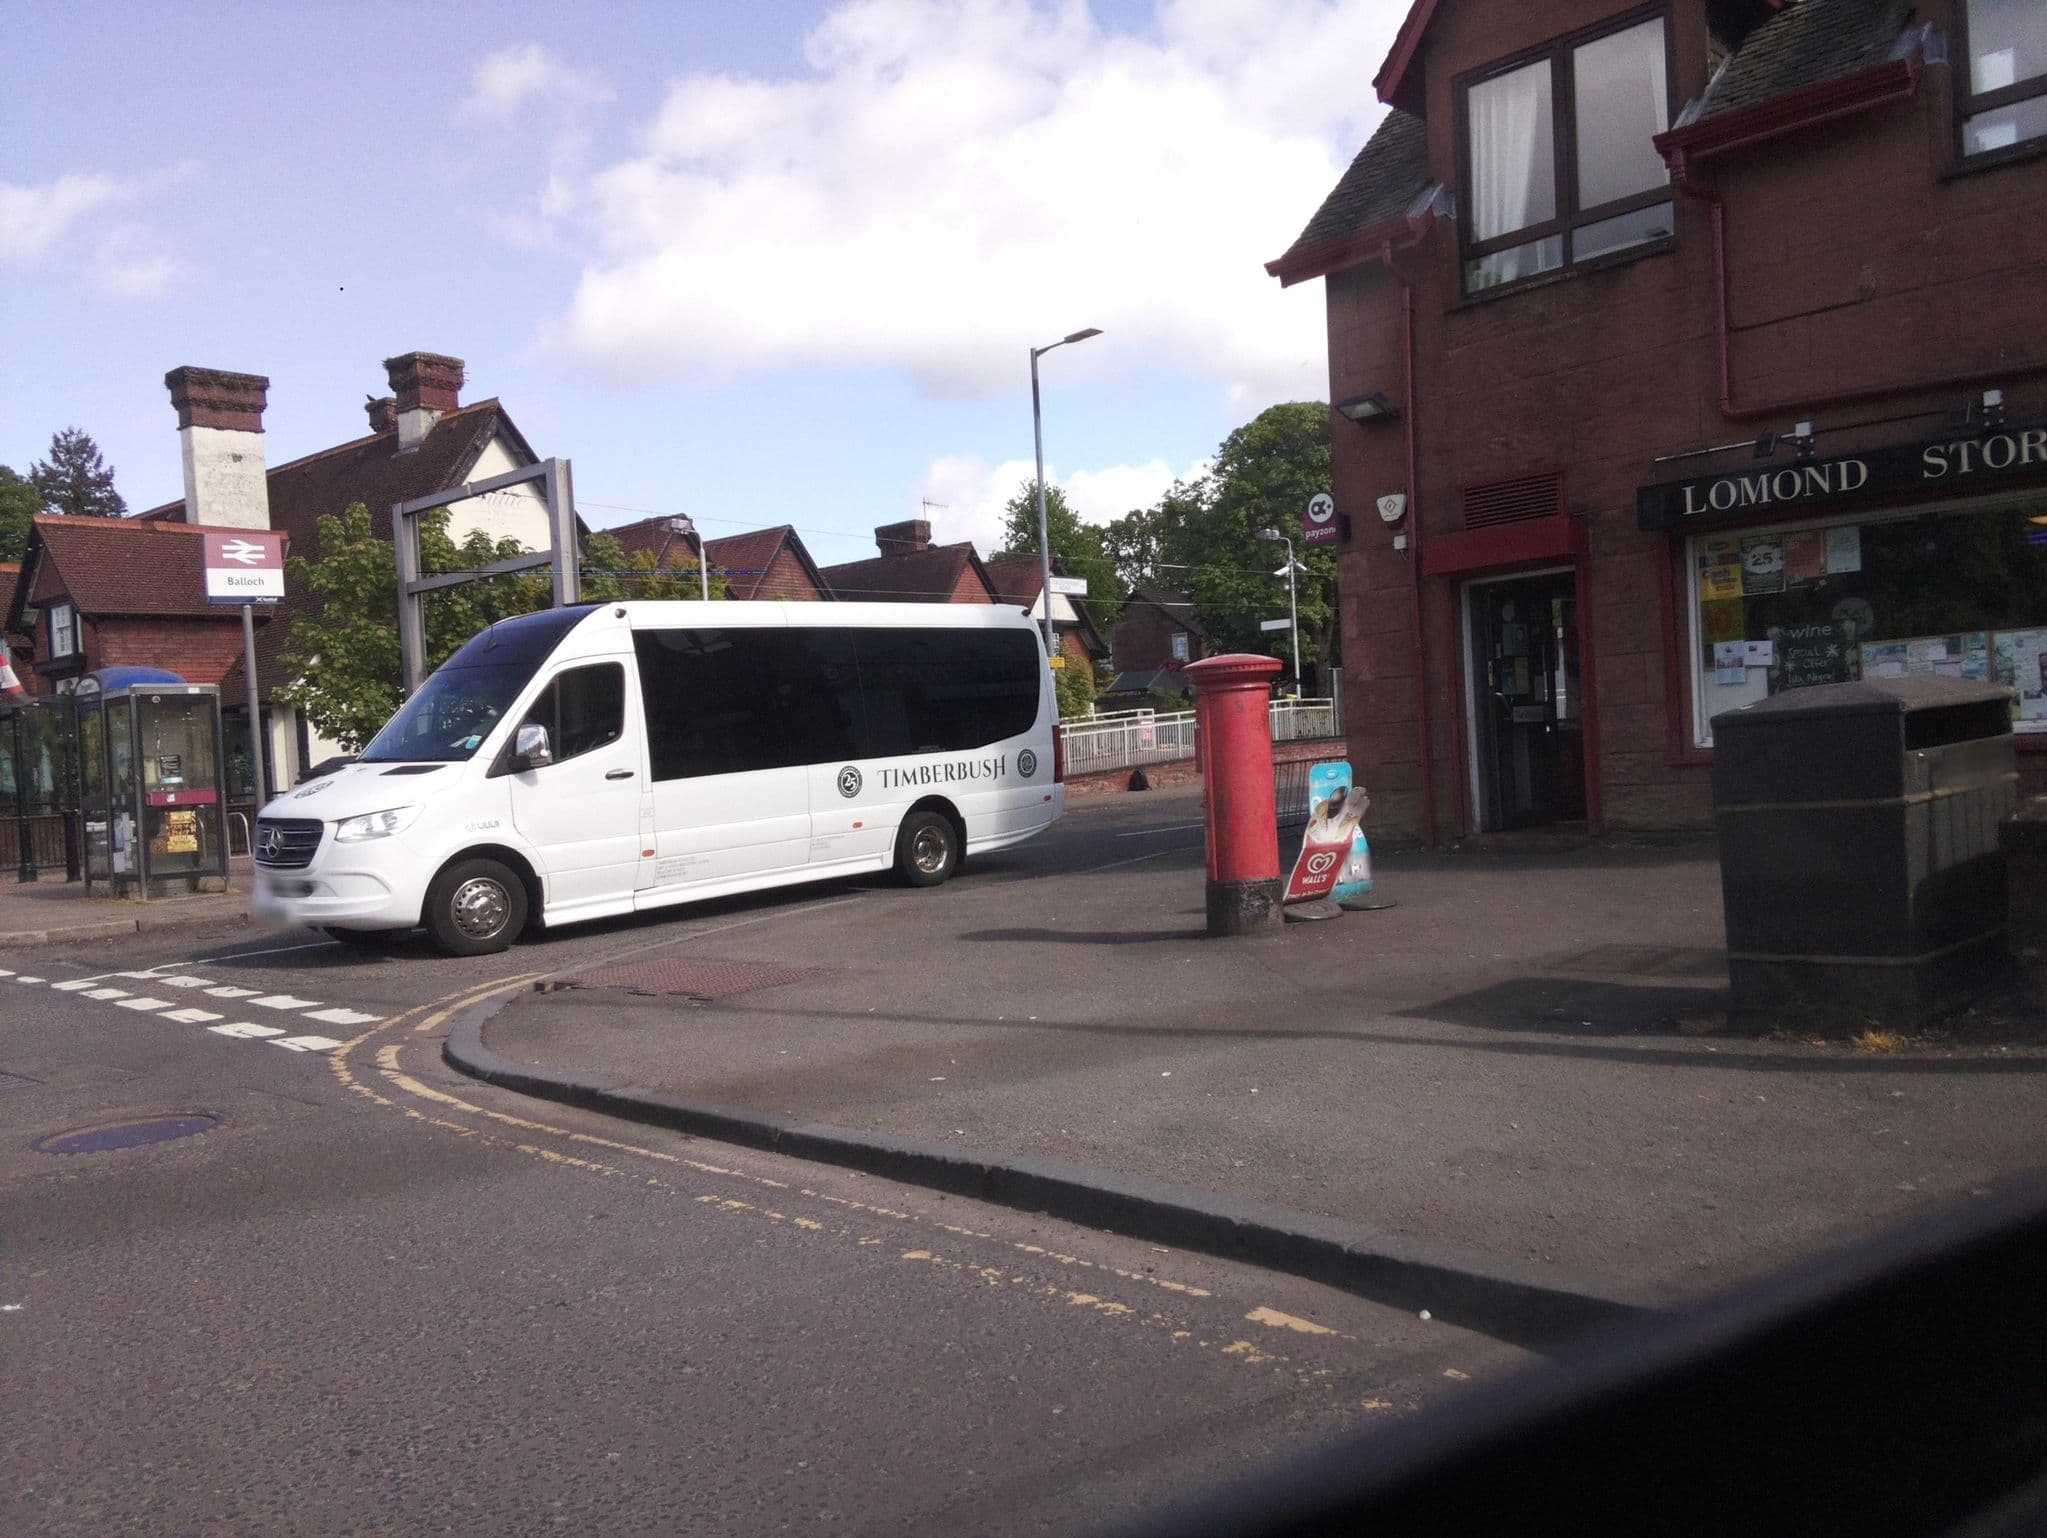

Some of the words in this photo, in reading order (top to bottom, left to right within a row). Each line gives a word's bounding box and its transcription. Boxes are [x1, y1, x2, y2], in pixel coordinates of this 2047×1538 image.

[1682, 459, 1868, 515] LOMOND
[1305, 527, 1336, 540] payzon
[227, 577, 264, 586] Balloch
[1789, 623, 1832, 639] wine
[876, 754, 1006, 789] TIMBERBUSH
[1302, 874, 1328, 885] WALL'S
